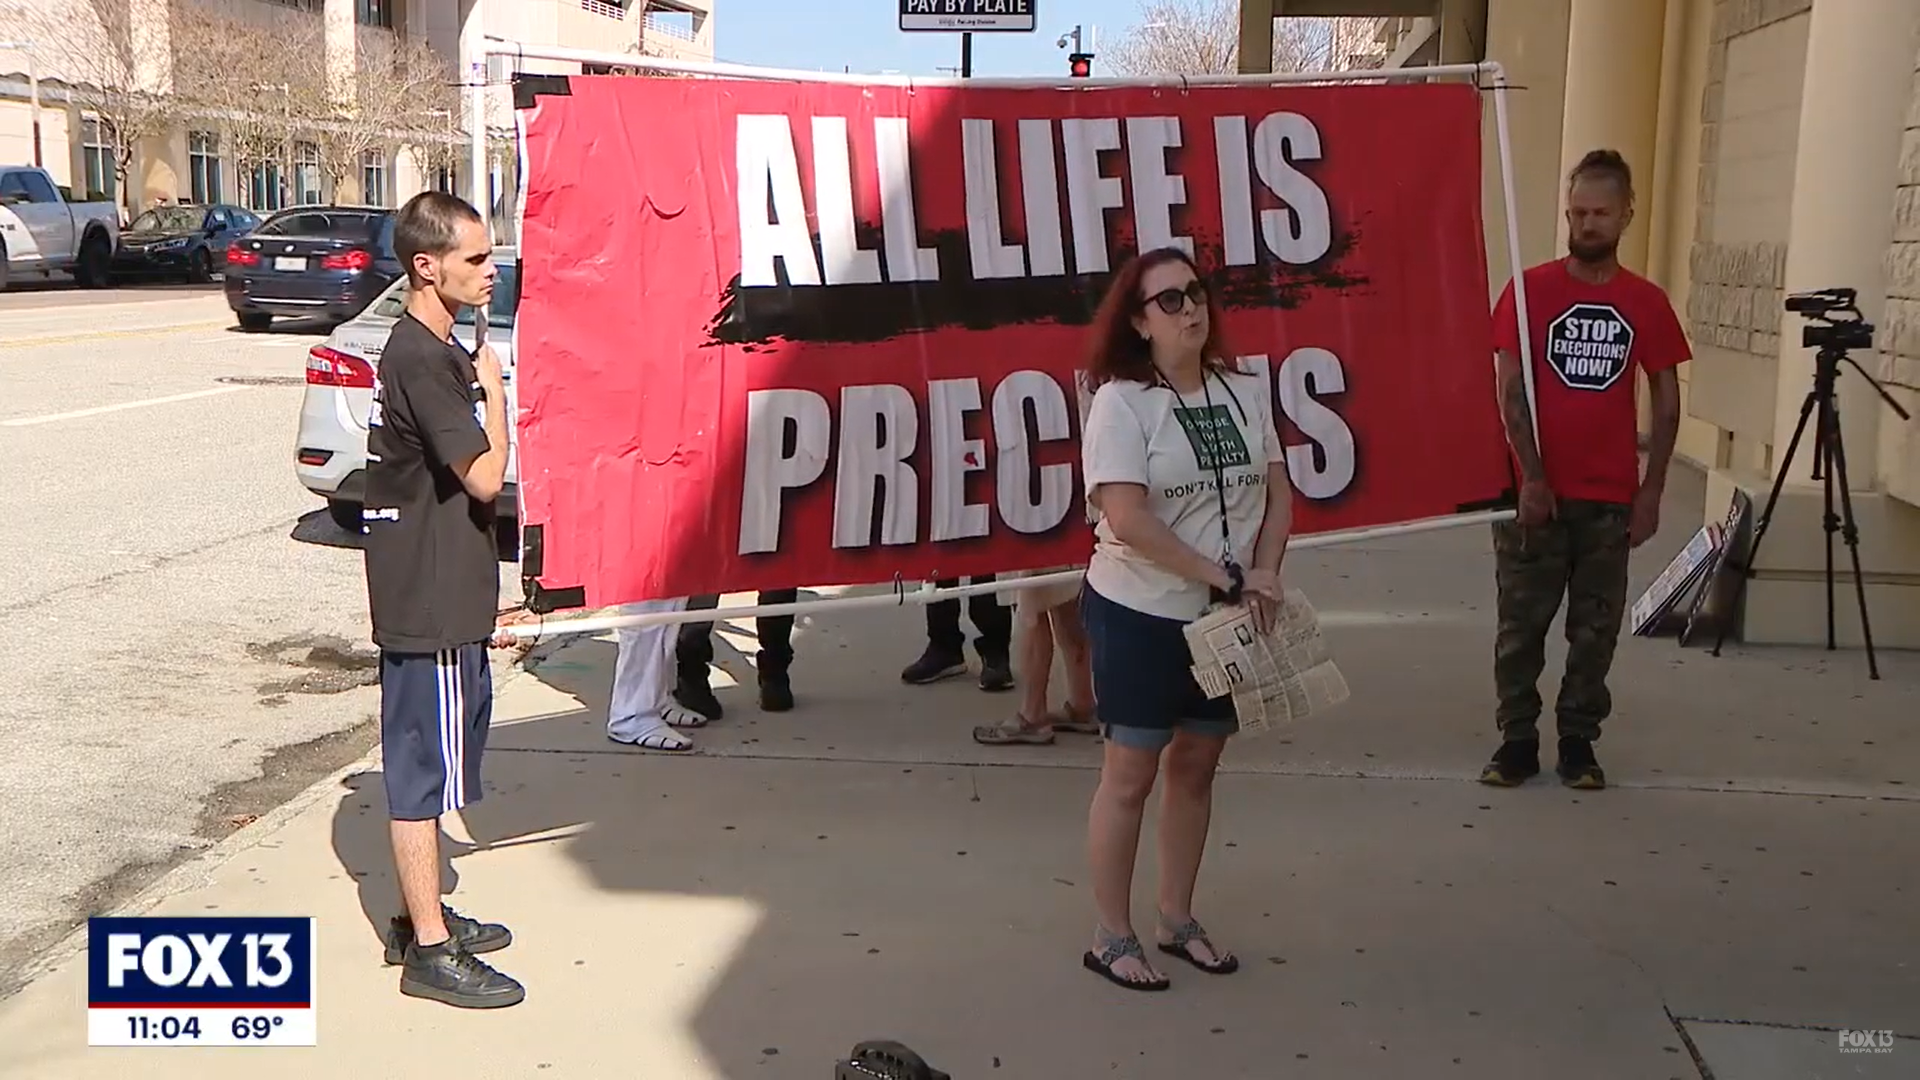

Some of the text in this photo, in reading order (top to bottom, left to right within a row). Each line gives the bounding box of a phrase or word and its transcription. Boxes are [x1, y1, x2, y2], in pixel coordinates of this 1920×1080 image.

[907, 0, 1027, 13] PAY BY PLATE
[736, 111, 1332, 287] ALL LIFE IS
[1564, 317, 1621, 342] STOP
[1553, 338, 1626, 361] EXECUTIONS
[1565, 356, 1612, 379] NOW!
[738, 347, 1356, 556] PRECS
[1164, 480, 1205, 499] DON'T
[1206, 476, 1234, 492] KL
[1237, 473, 1260, 487] FOR
